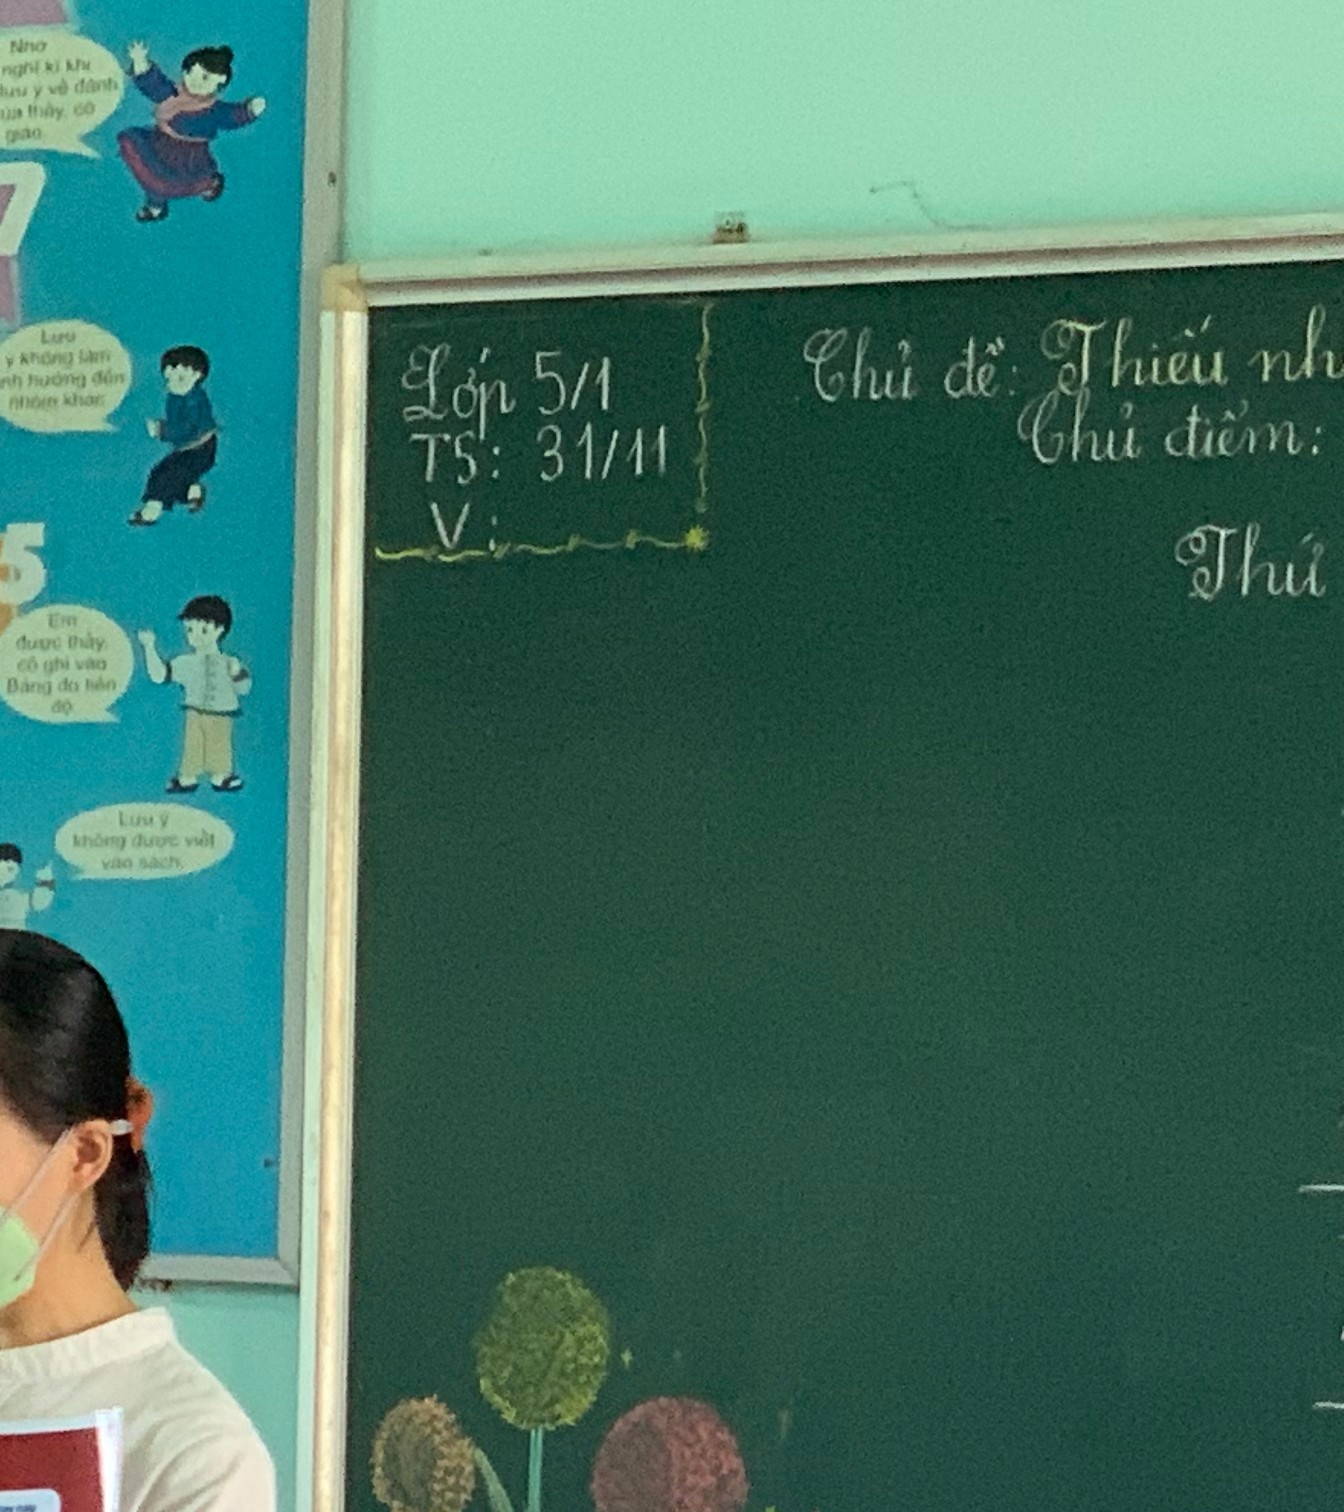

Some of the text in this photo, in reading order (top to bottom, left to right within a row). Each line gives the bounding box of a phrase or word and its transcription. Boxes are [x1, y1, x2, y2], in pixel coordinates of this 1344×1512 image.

[402, 342, 610, 442] Lớp 5/1
[804, 326, 915, 402] Chủ
[1040, 314, 1229, 396] Thiếu
[1018, 390, 1142, 464] Chủ
